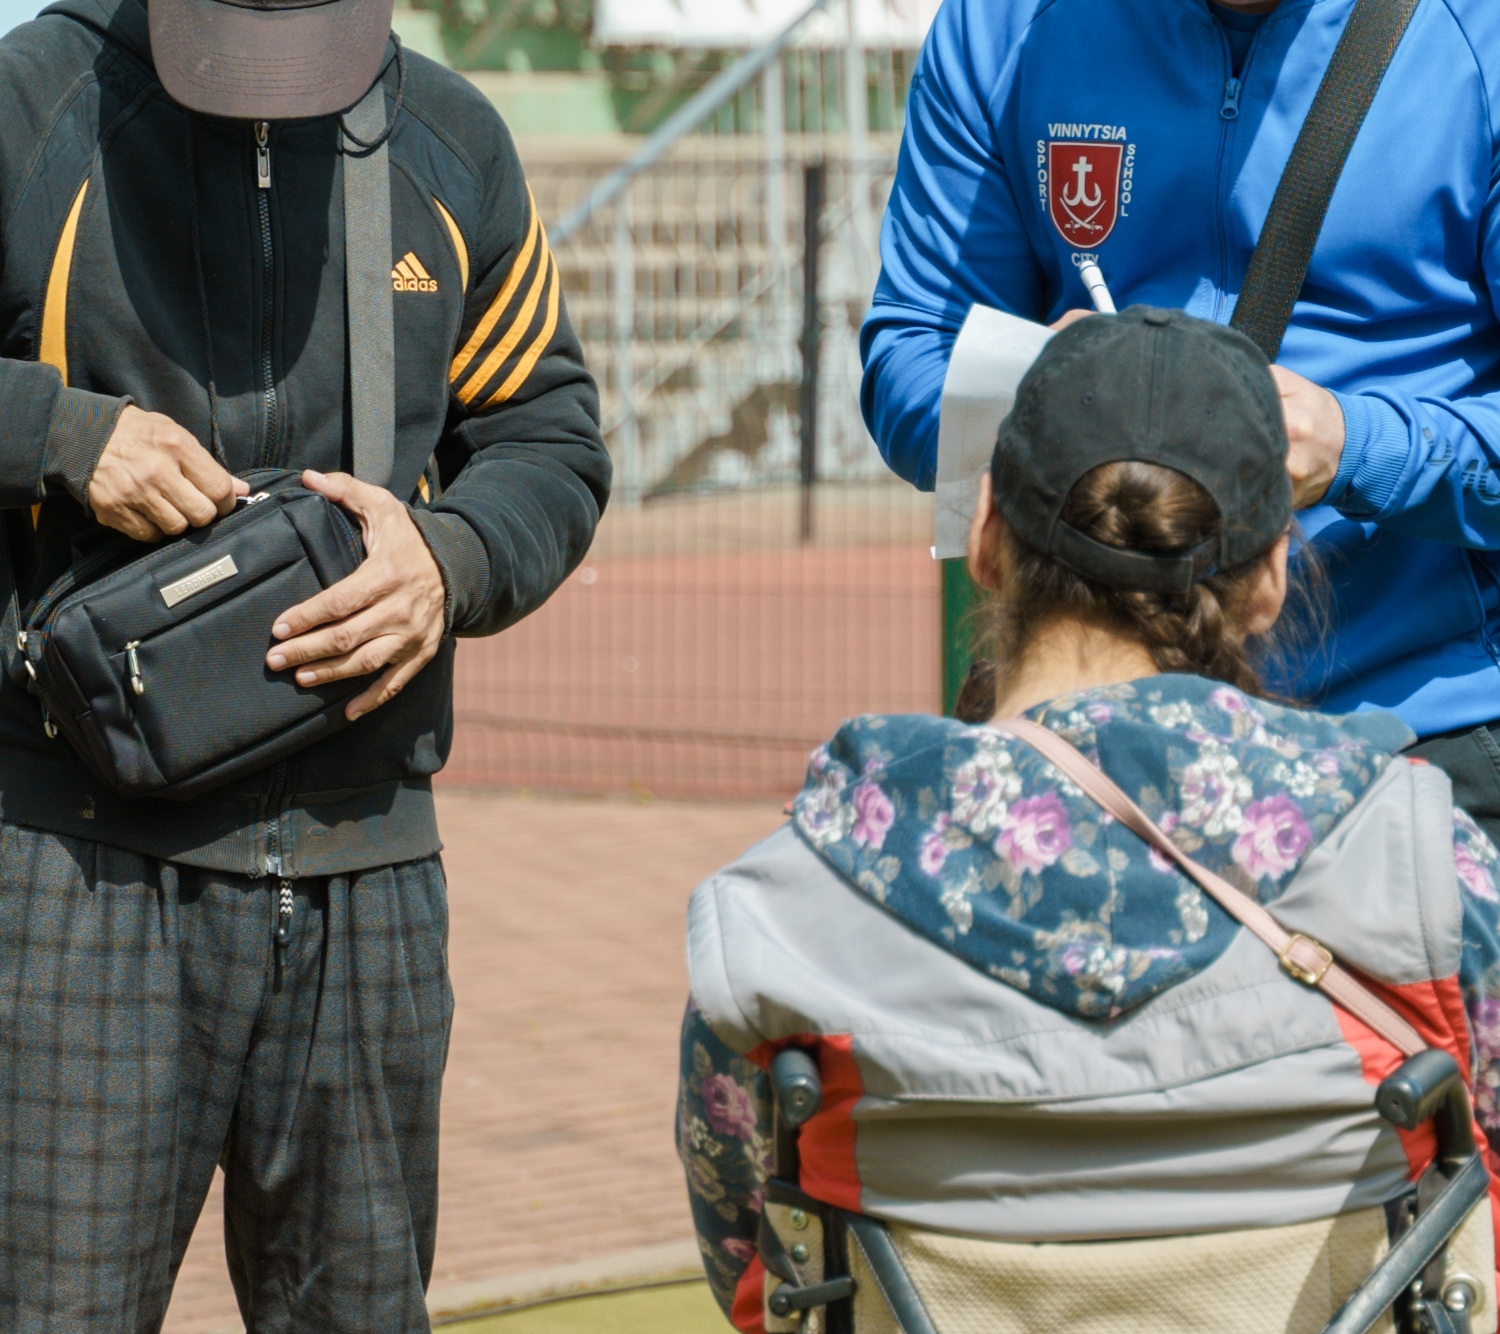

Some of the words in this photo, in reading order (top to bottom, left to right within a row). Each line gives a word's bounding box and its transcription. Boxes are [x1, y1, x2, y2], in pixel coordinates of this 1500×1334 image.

[1048, 123, 1126, 140] VINNYTSIA
[1037, 140, 1047, 211] SPORT
[1121, 144, 1136, 216] SCHOOL
[393, 279, 437, 291] didas
